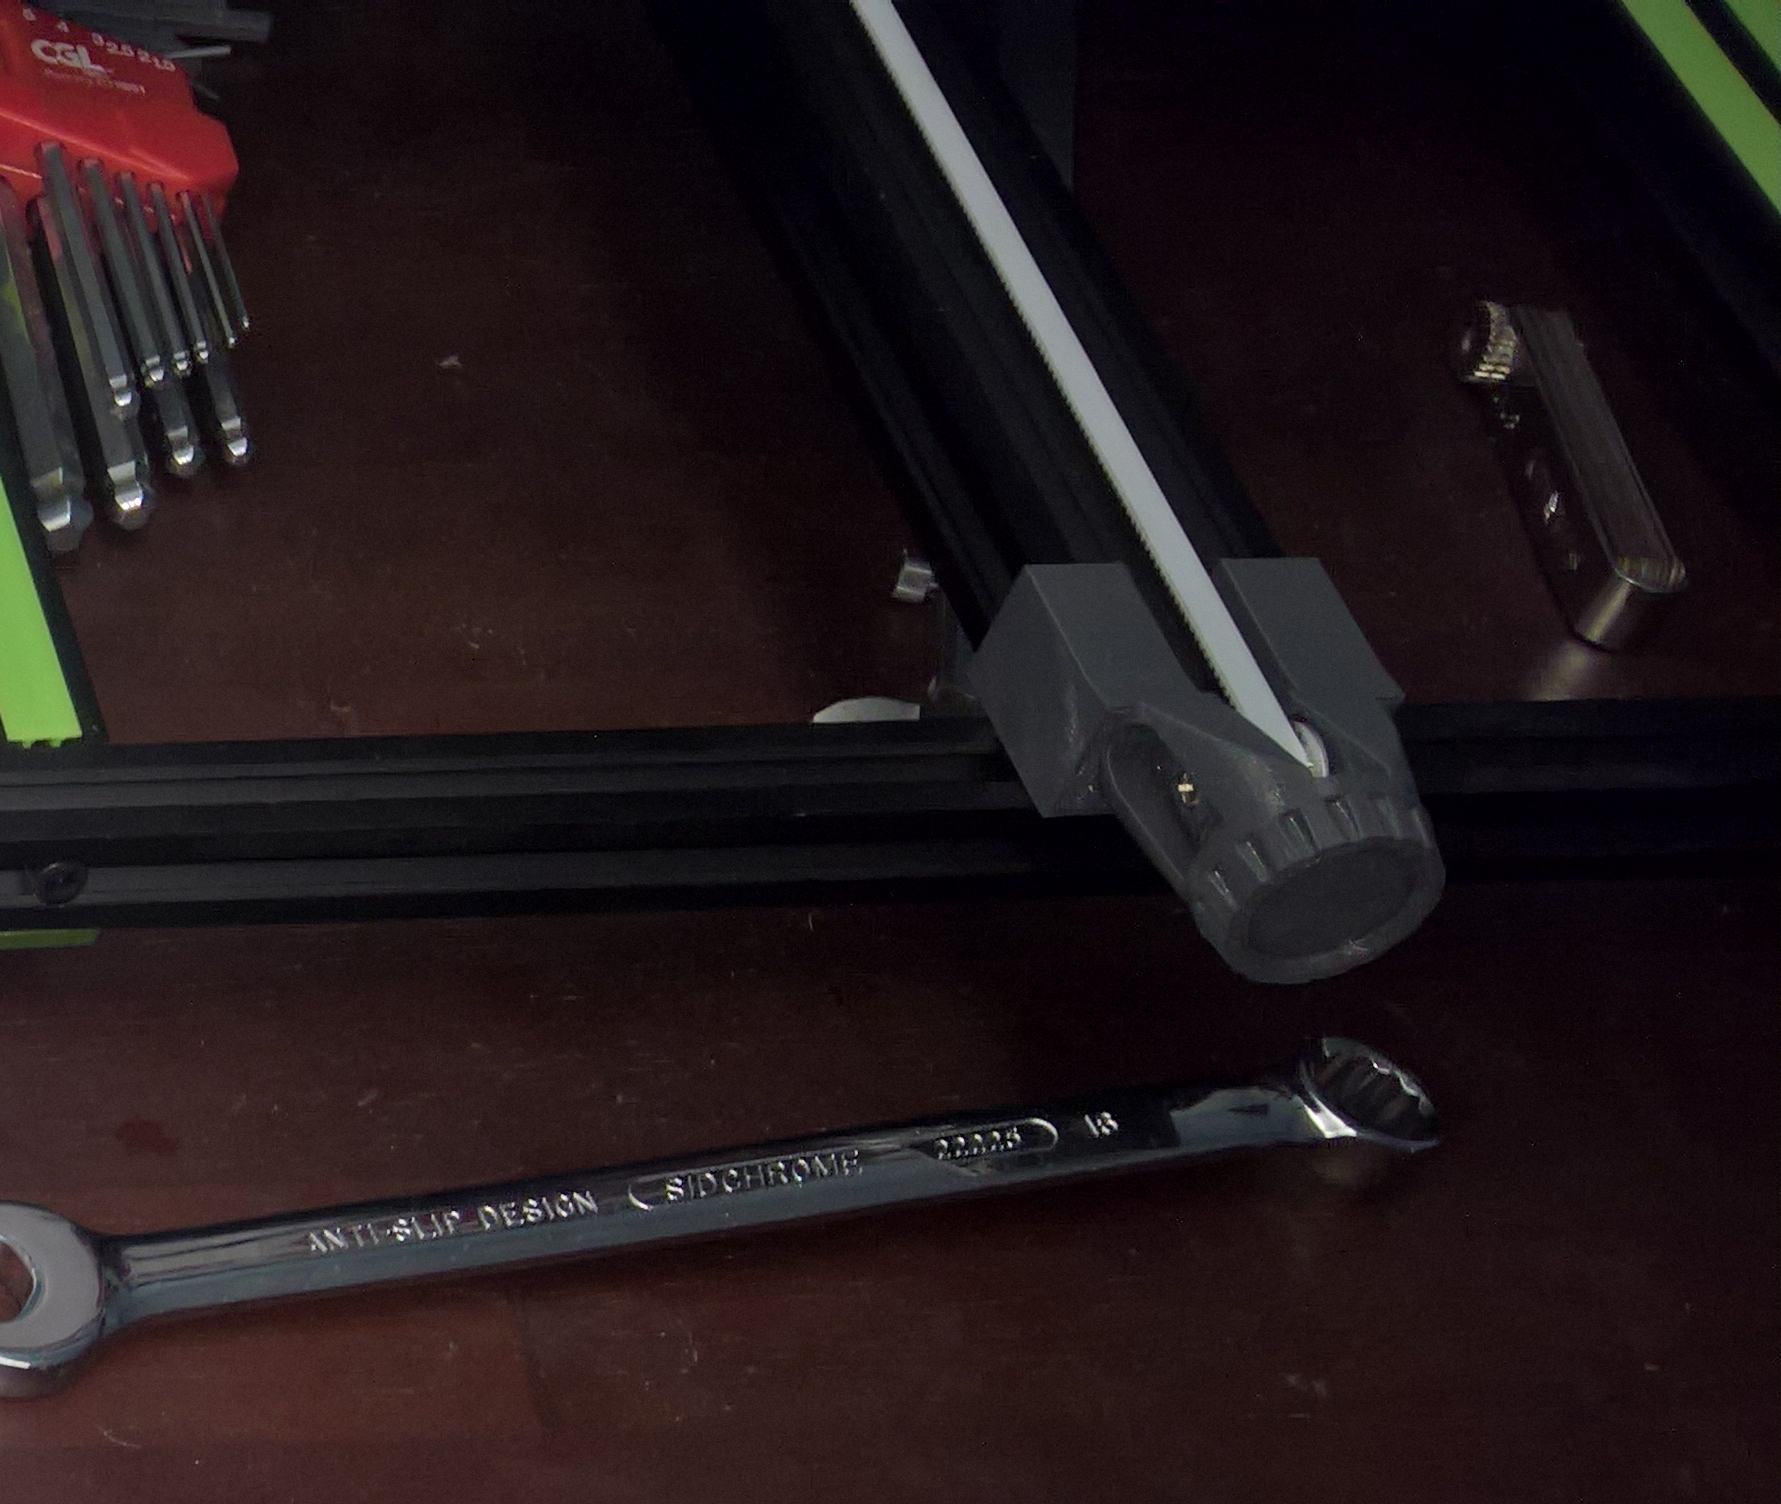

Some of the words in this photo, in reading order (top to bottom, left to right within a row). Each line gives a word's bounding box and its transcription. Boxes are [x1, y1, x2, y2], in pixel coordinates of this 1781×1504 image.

[31, 38, 108, 77] CGL
[664, 1149, 864, 1202] SIDCHROME
[477, 1190, 598, 1231] DESIGN
